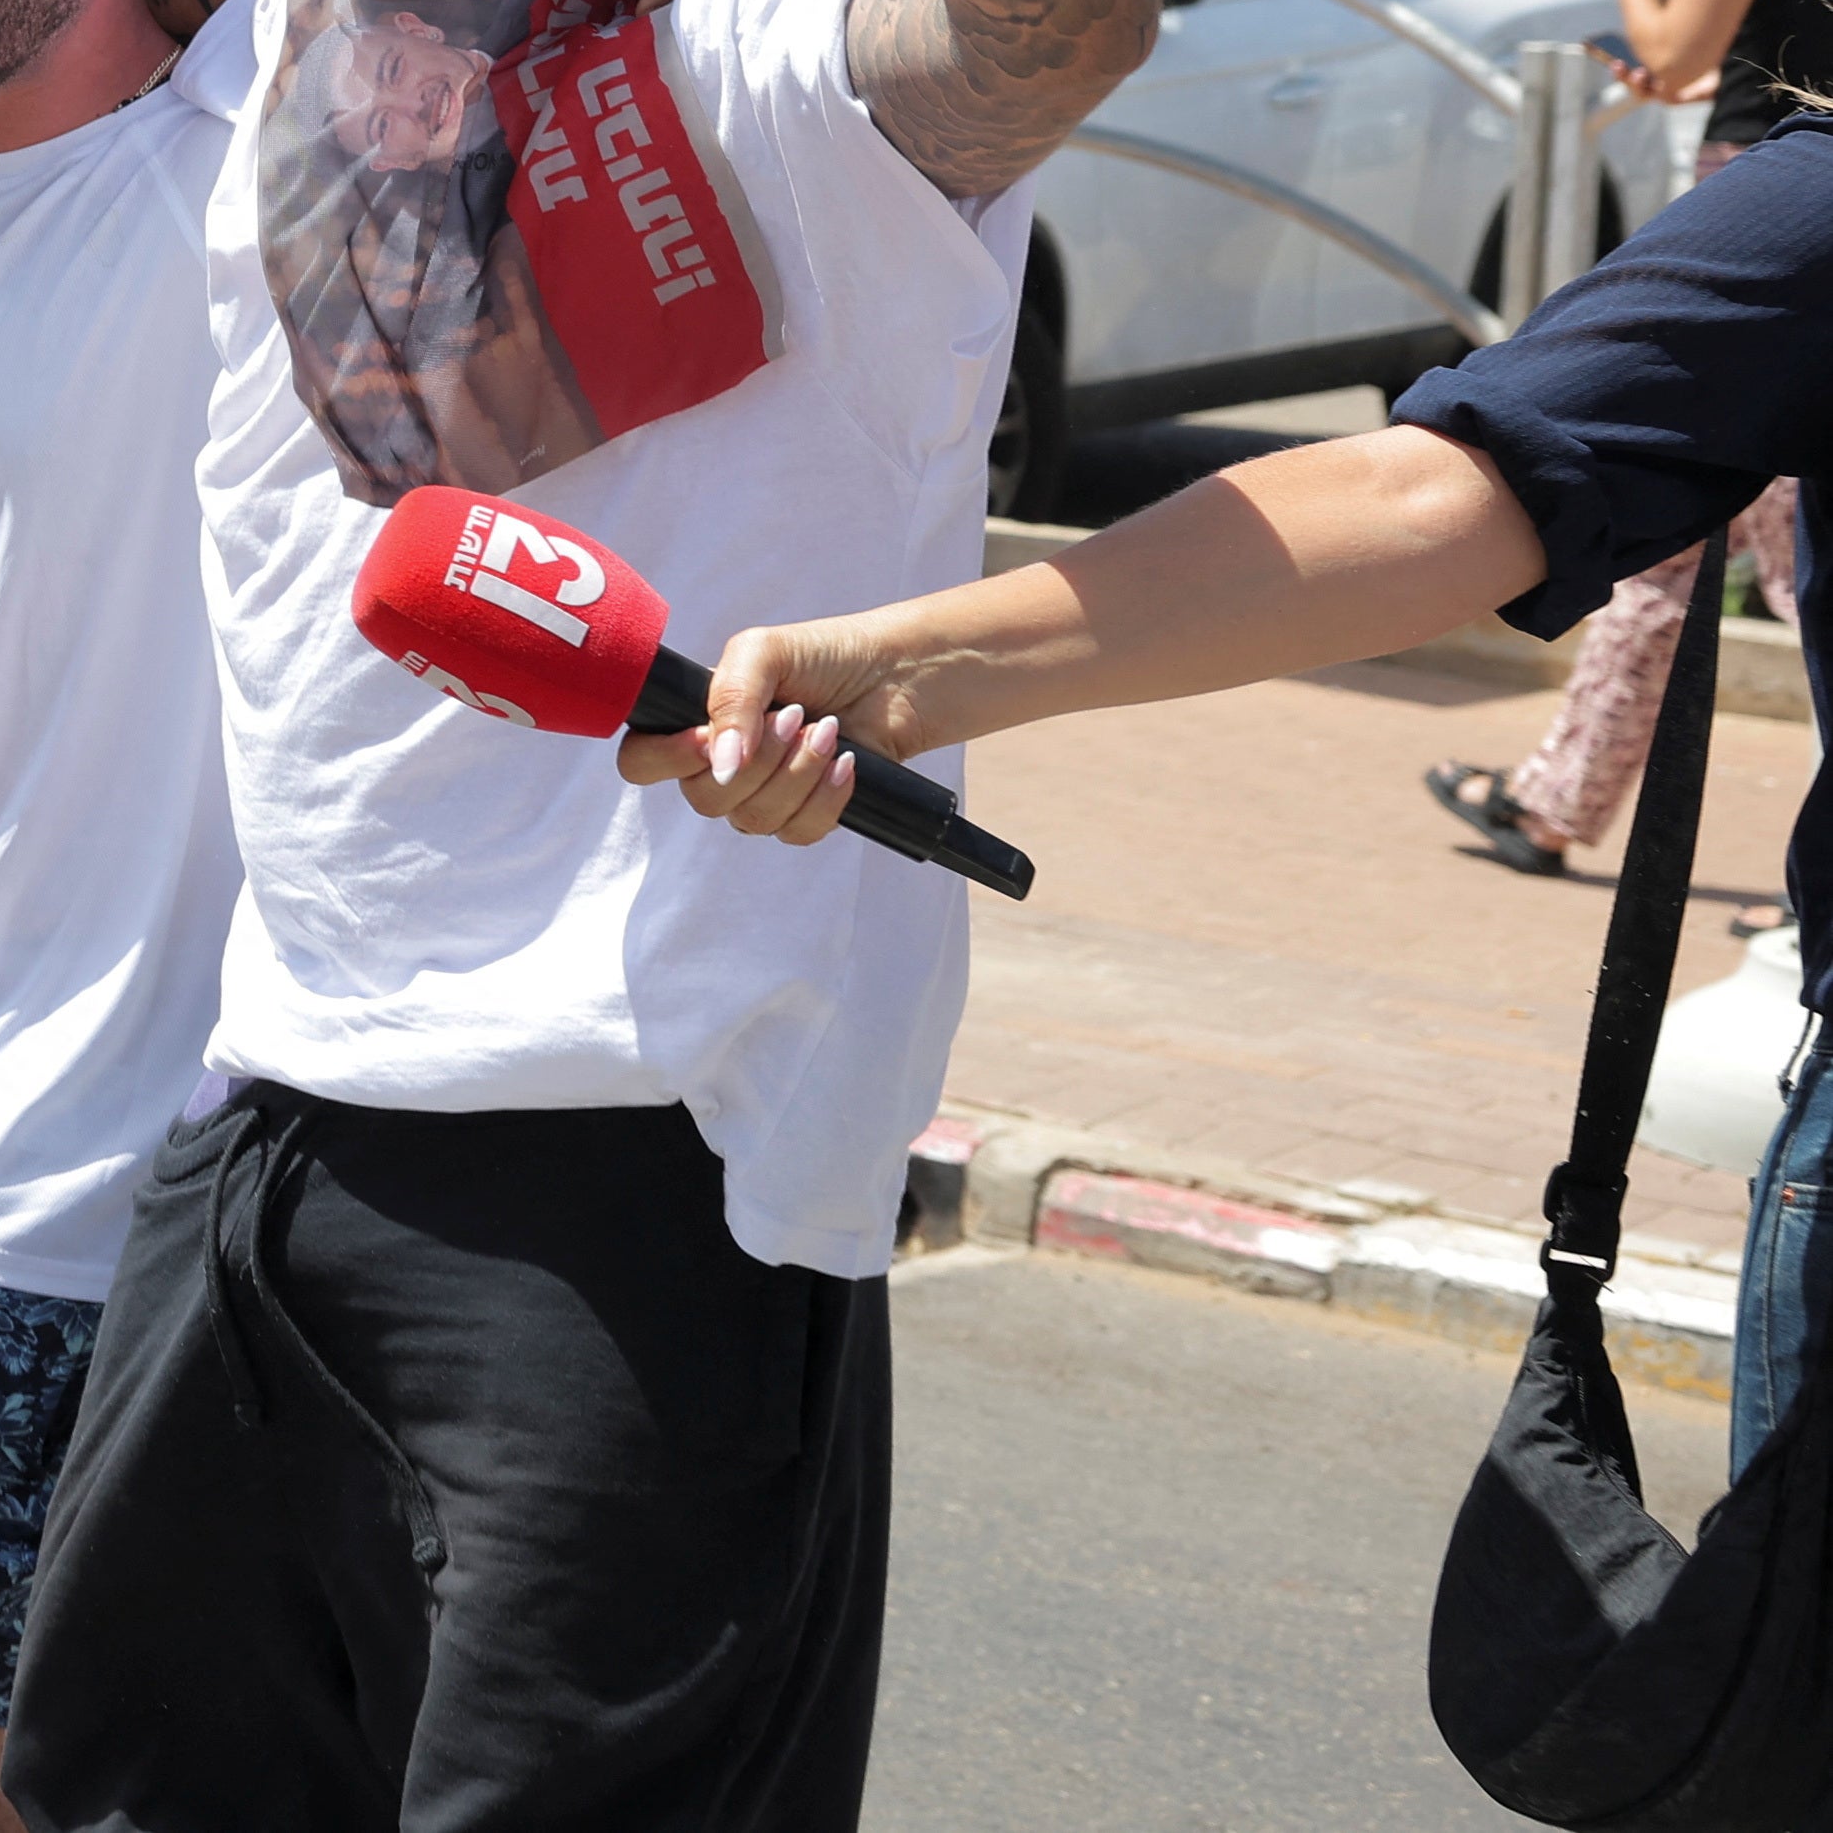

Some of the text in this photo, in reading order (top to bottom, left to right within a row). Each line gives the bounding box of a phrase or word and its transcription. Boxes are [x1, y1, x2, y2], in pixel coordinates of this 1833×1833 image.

[577, 57, 717, 306] הביתה!
[443, 504, 495, 592] חדשות
[470, 512, 606, 649] 13
